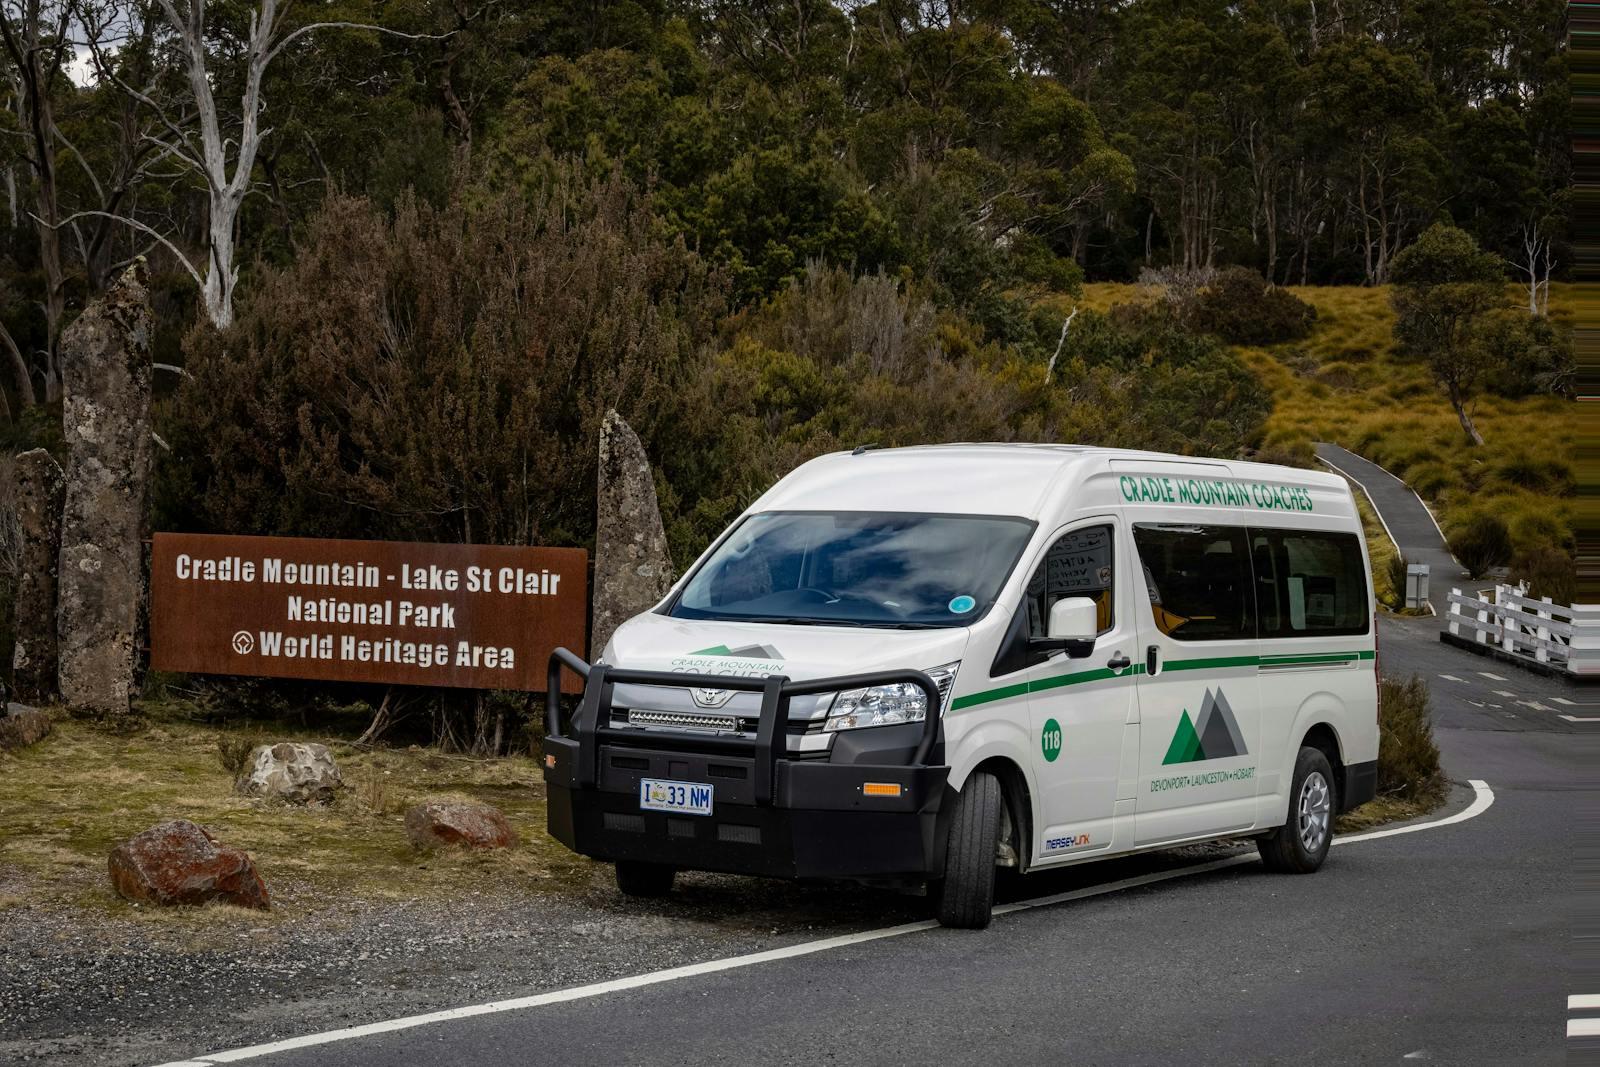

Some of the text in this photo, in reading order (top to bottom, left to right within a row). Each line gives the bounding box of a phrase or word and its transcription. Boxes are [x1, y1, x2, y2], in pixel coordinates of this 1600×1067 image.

[1120, 476, 1313, 511] CRADLE MOUNTAIN COACHES
[176, 553, 256, 583] Cradle
[262, 557, 380, 588] Mountain
[401, 563, 459, 592] Lake
[466, 565, 492, 593] St
[498, 566, 561, 596] Clair
[287, 595, 456, 629] National Park
[259, 630, 515, 670] World Heritage Area
[671, 658, 784, 672] CRADLE MOUNTAIN
[1043, 731, 1061, 750] 118
[1150, 766, 1256, 793] DEVONPORT LAUNCESTON HOBART
[667, 786, 686, 806] 33
[690, 787, 710, 809] NM
